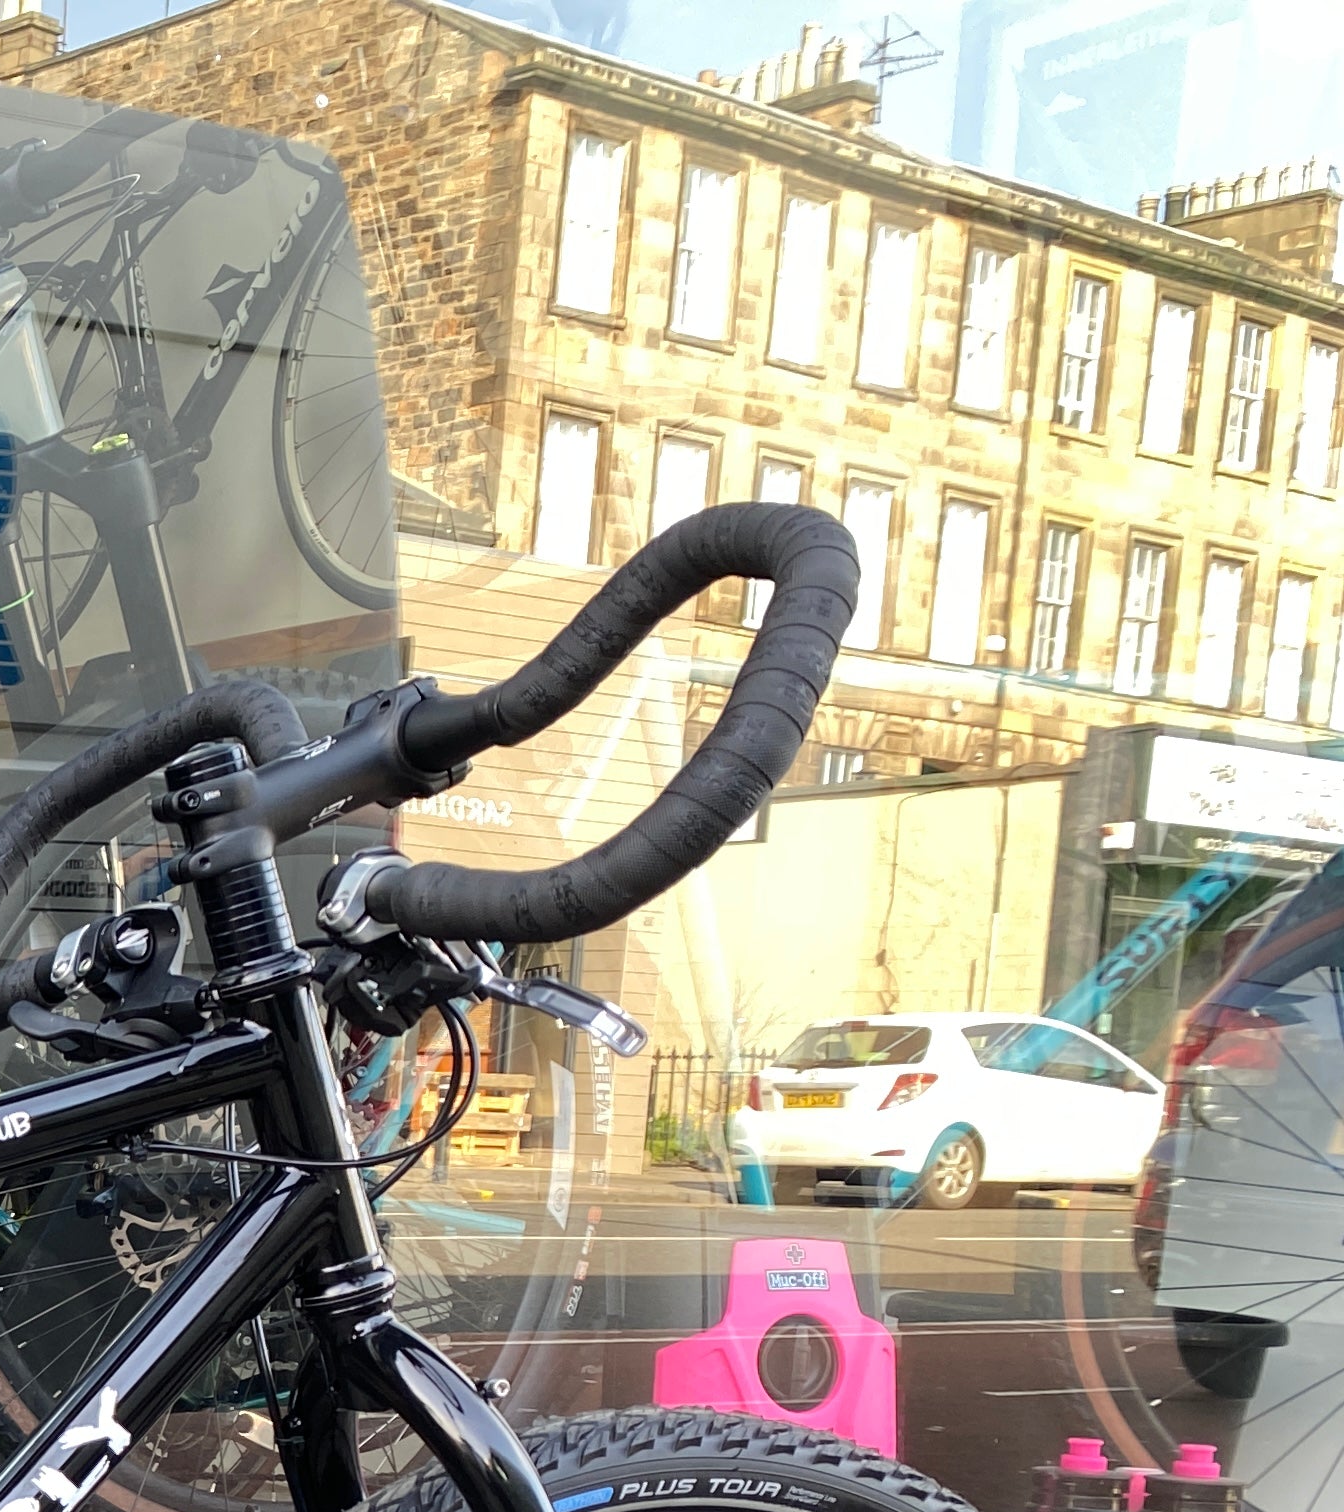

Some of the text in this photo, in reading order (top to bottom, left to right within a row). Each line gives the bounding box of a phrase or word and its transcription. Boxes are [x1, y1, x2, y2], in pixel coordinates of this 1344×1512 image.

[769, 1270, 828, 1289] Muc-Off
[618, 1477, 699, 1500] PLUS
[707, 1476, 784, 1497] TOUR
